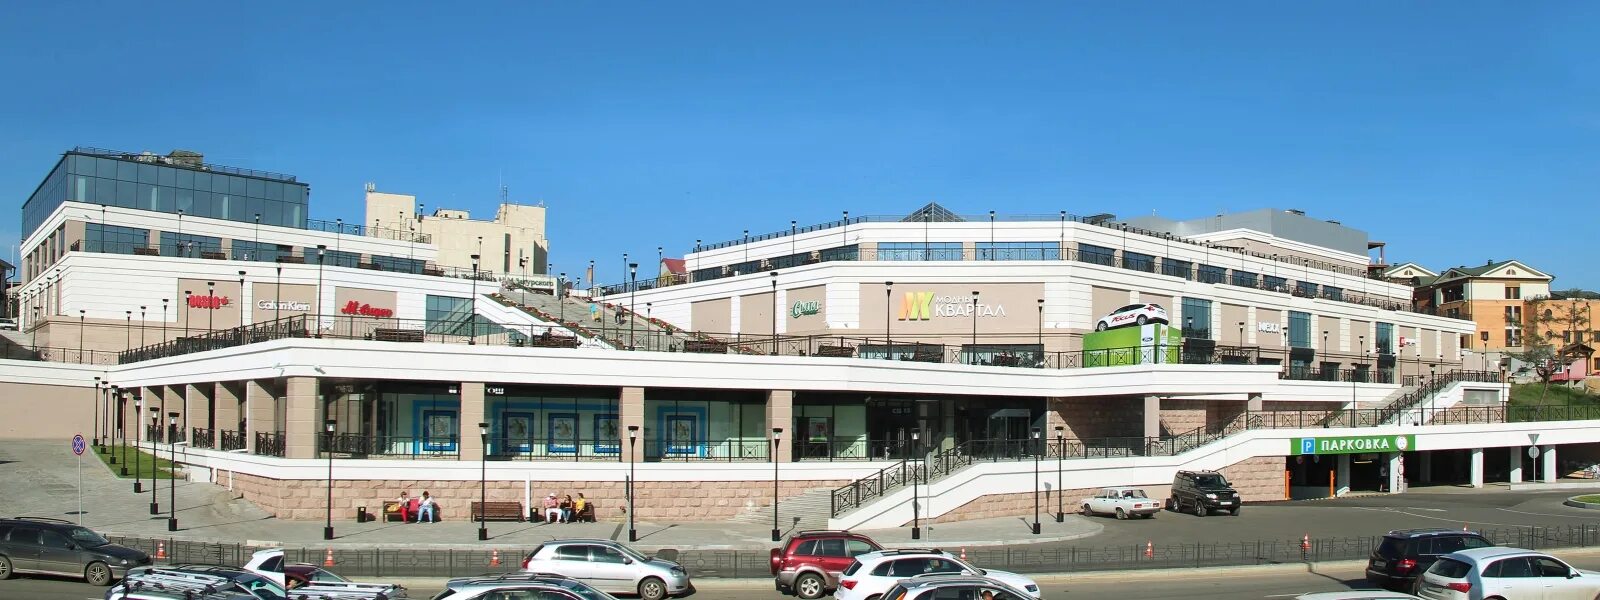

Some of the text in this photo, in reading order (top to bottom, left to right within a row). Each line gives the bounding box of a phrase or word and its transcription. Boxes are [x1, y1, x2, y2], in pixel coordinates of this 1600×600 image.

[288, 301, 311, 311] Klein
[935, 304, 1006, 317] КВАРТАЛ
[1321, 438, 1390, 451] ПАРКОВКА
